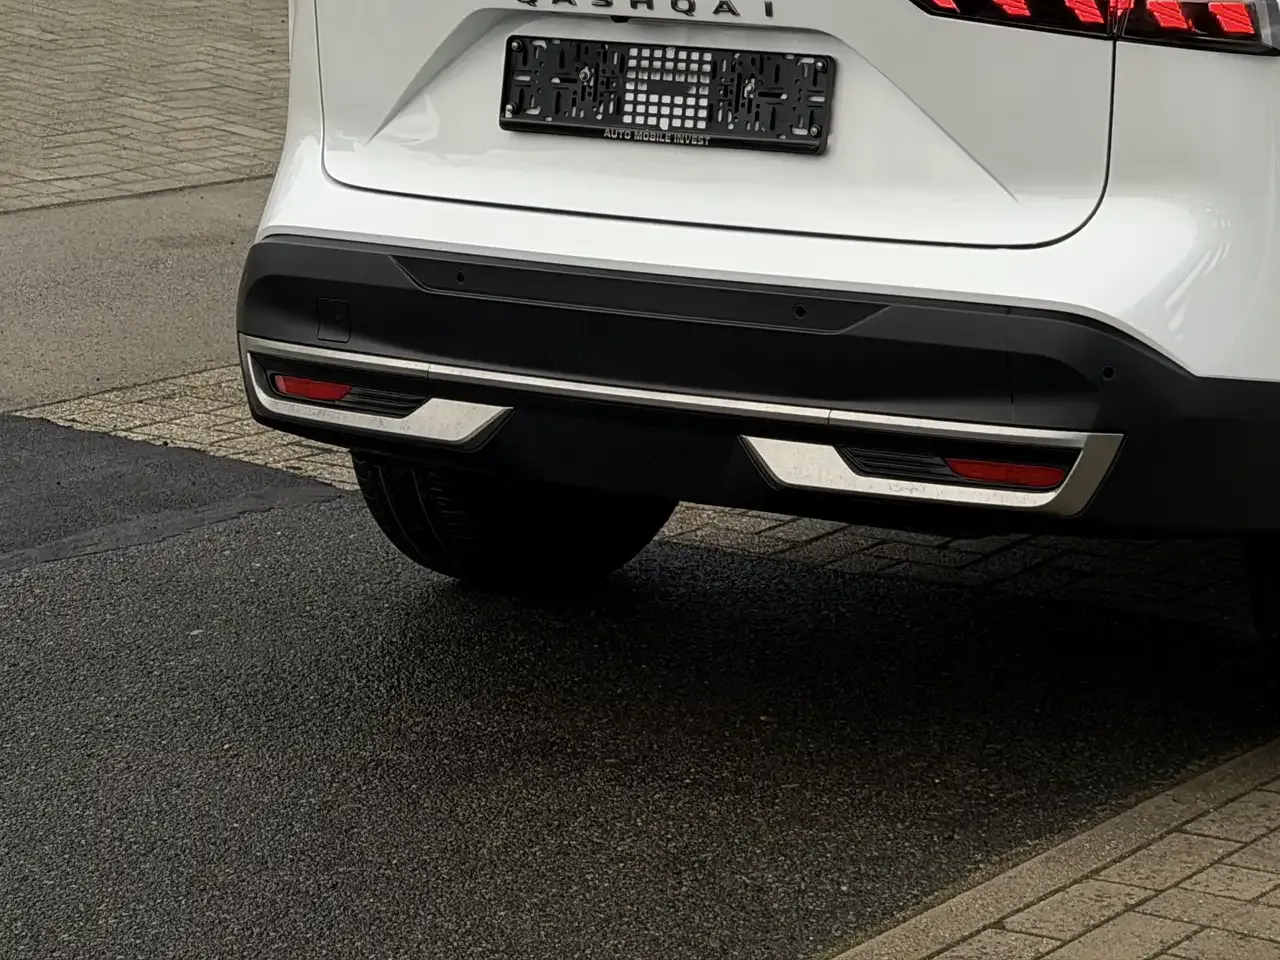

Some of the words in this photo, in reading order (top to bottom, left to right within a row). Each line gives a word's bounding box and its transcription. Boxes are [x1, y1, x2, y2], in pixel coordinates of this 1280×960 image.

[603, 128, 631, 140] AUTO
[634, 130, 671, 142] MOBILE
[674, 133, 711, 145] INVEST
